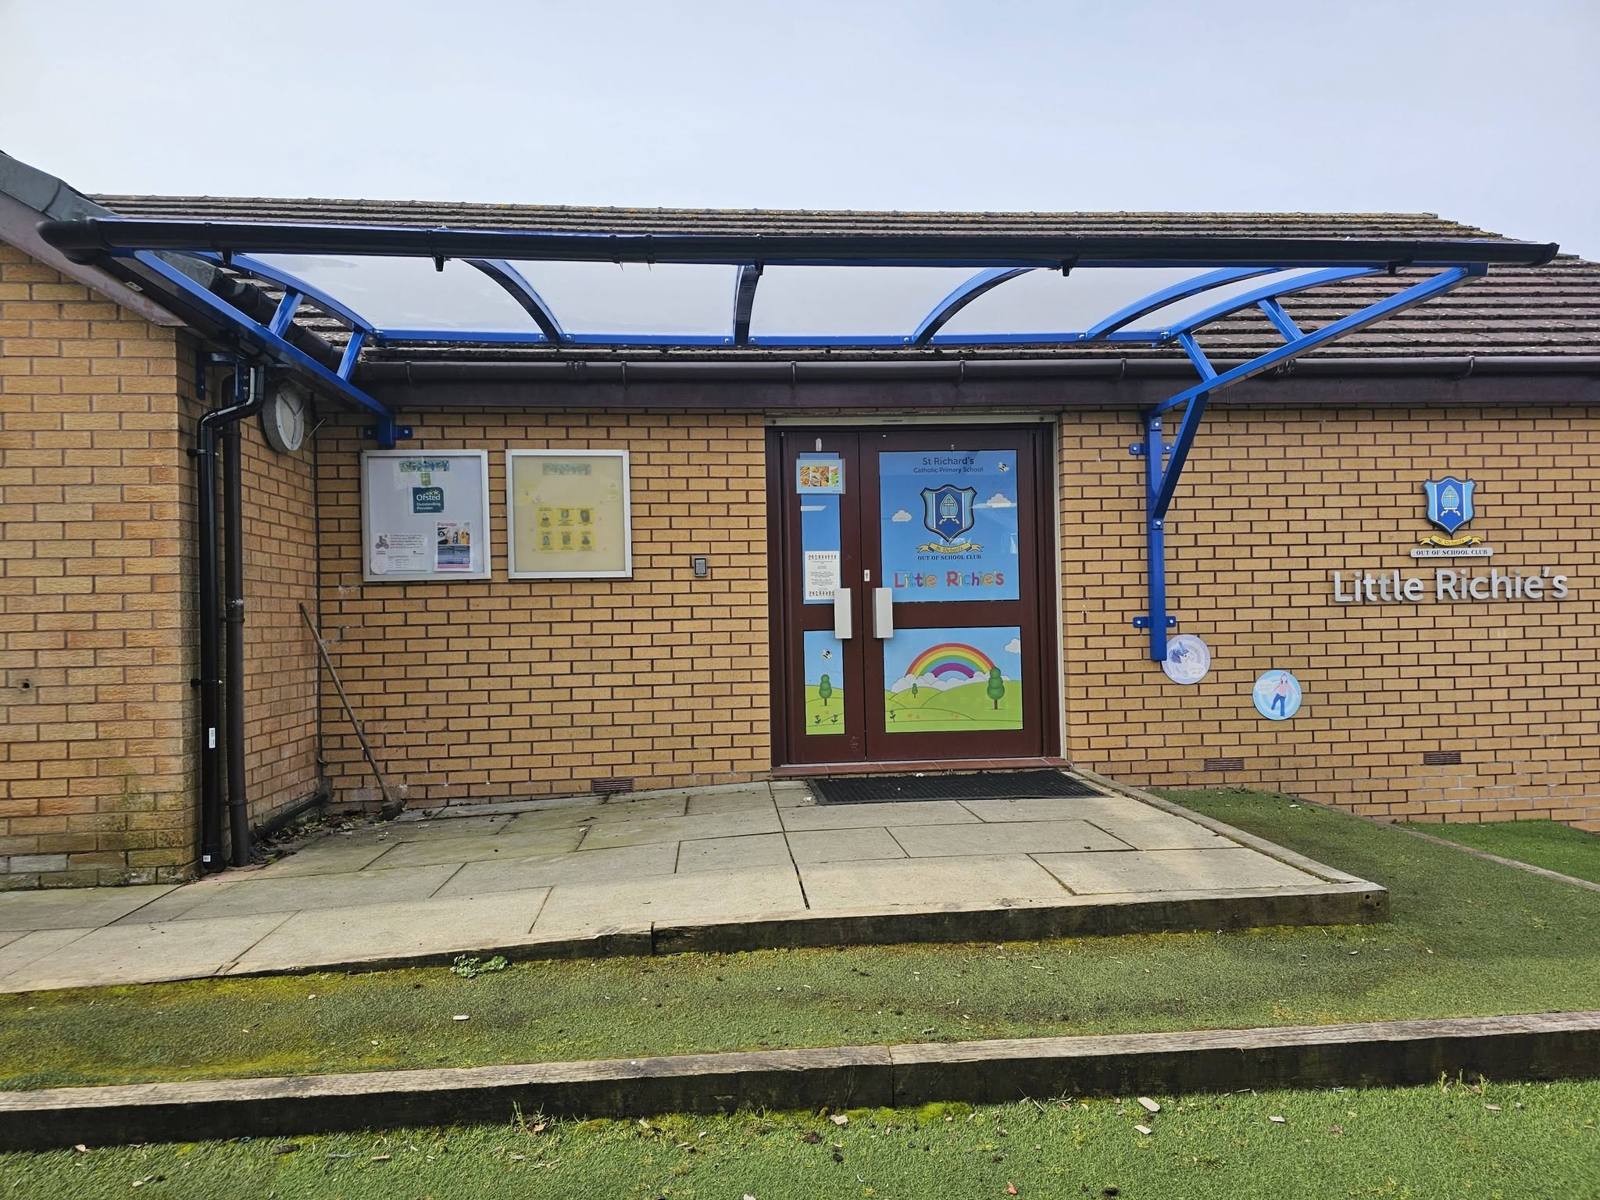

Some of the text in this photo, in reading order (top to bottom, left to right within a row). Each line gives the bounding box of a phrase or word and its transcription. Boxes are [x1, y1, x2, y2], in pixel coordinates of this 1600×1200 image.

[922, 456, 975, 465] St Richard's
[894, 570, 1004, 588] Little Richie's
[1334, 567, 1569, 602] Little Richie's
